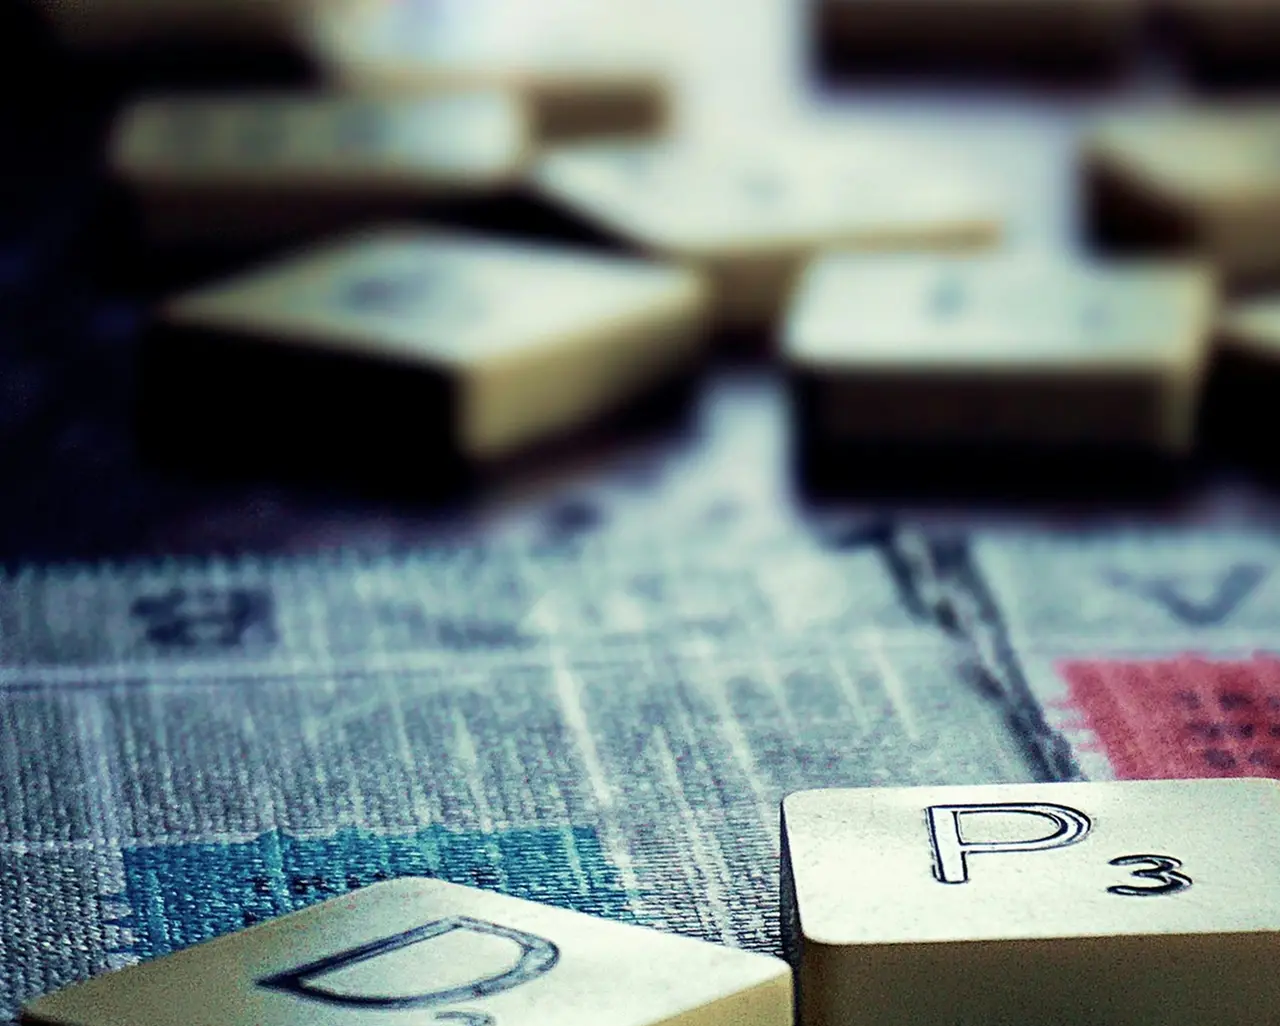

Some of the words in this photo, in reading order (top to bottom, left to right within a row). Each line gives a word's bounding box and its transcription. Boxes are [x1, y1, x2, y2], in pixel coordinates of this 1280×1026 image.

[923, 802, 1096, 885] P
[1104, 853, 1194, 897] 3
[254, 914, 562, 1011] D
